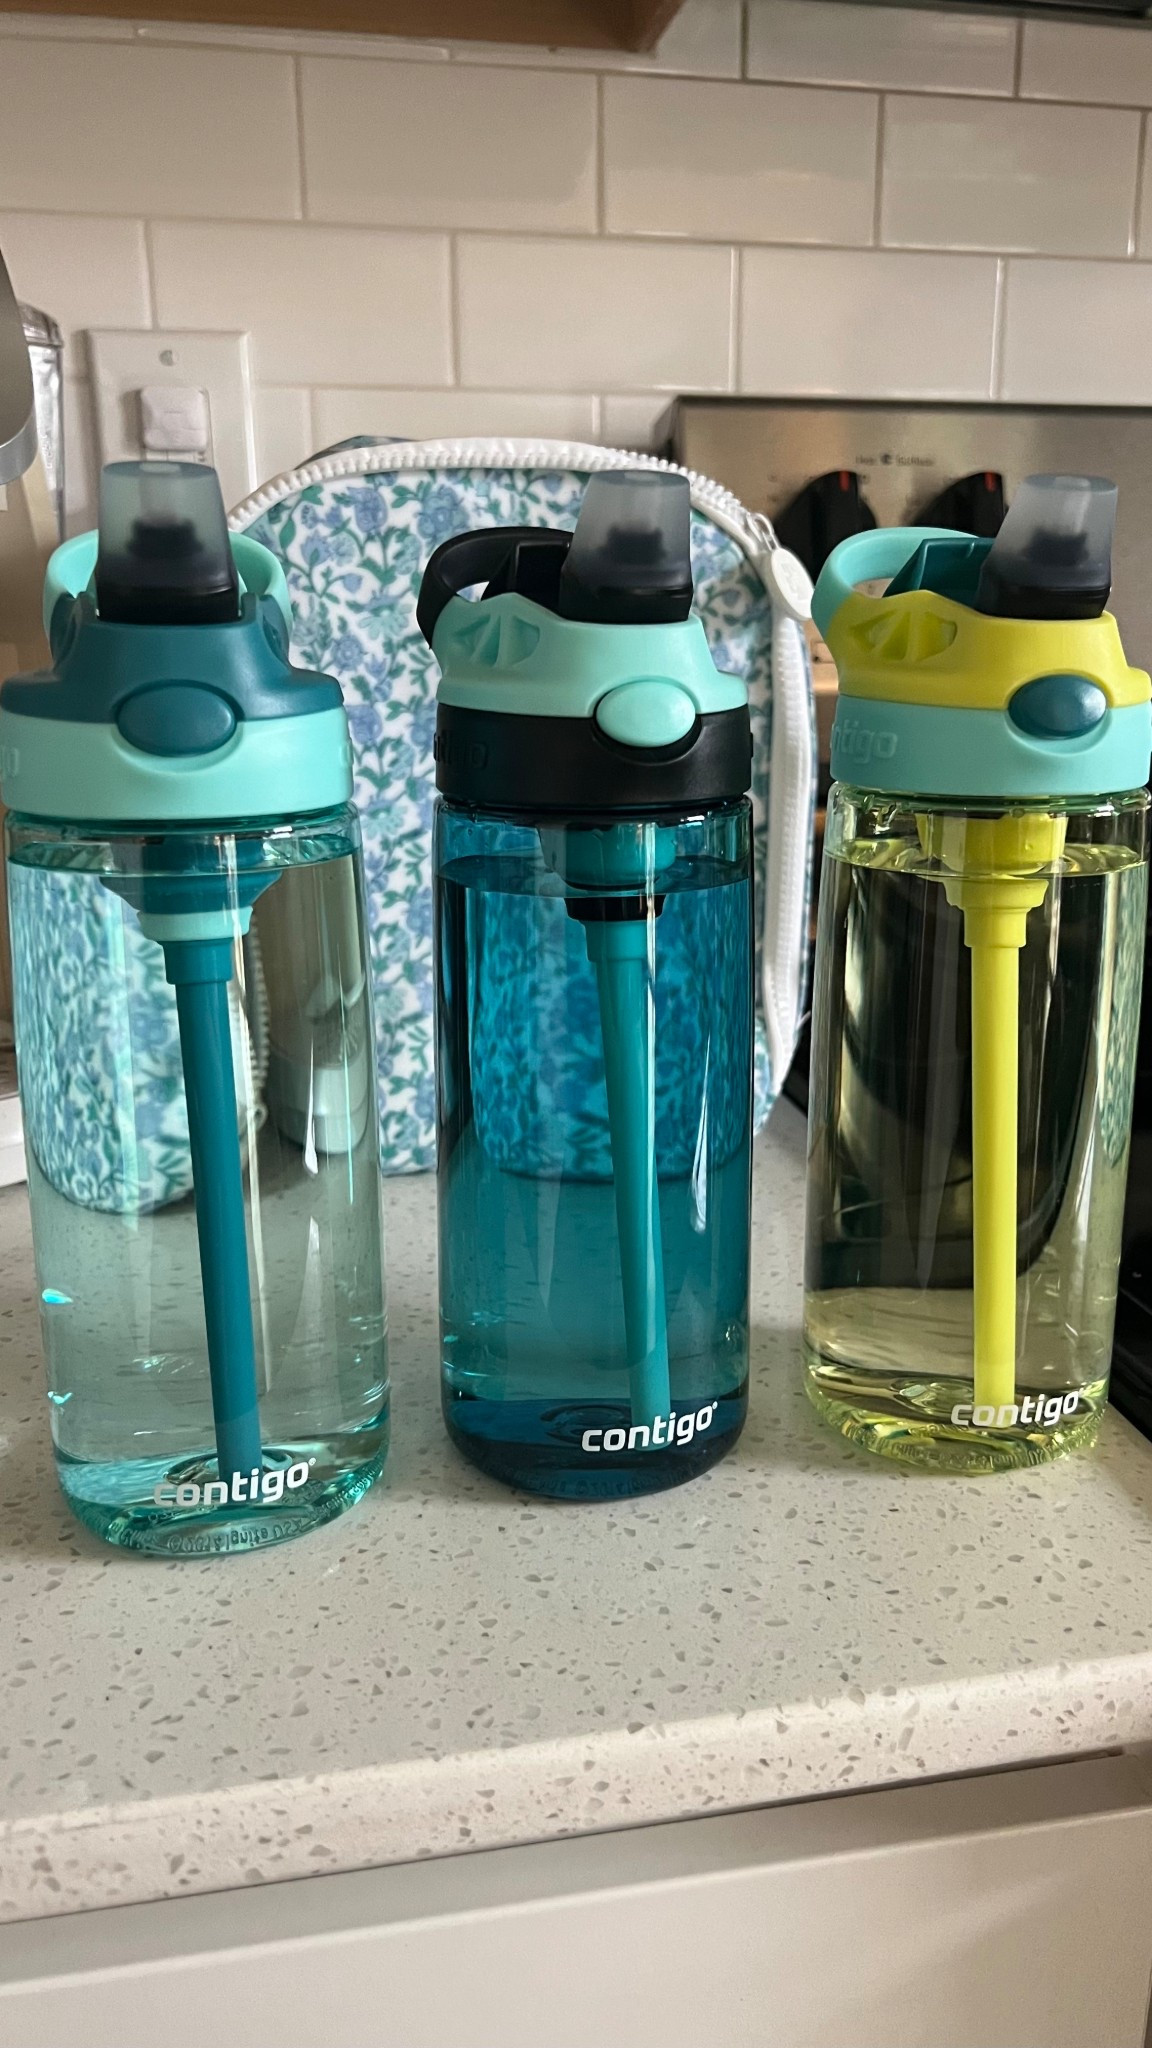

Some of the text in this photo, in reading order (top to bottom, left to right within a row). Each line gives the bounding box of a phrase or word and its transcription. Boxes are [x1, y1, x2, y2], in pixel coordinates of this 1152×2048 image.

[582, 1404, 714, 1452] contigo
[951, 1391, 1080, 1428] contigo
[153, 1461, 311, 1507] contigo
